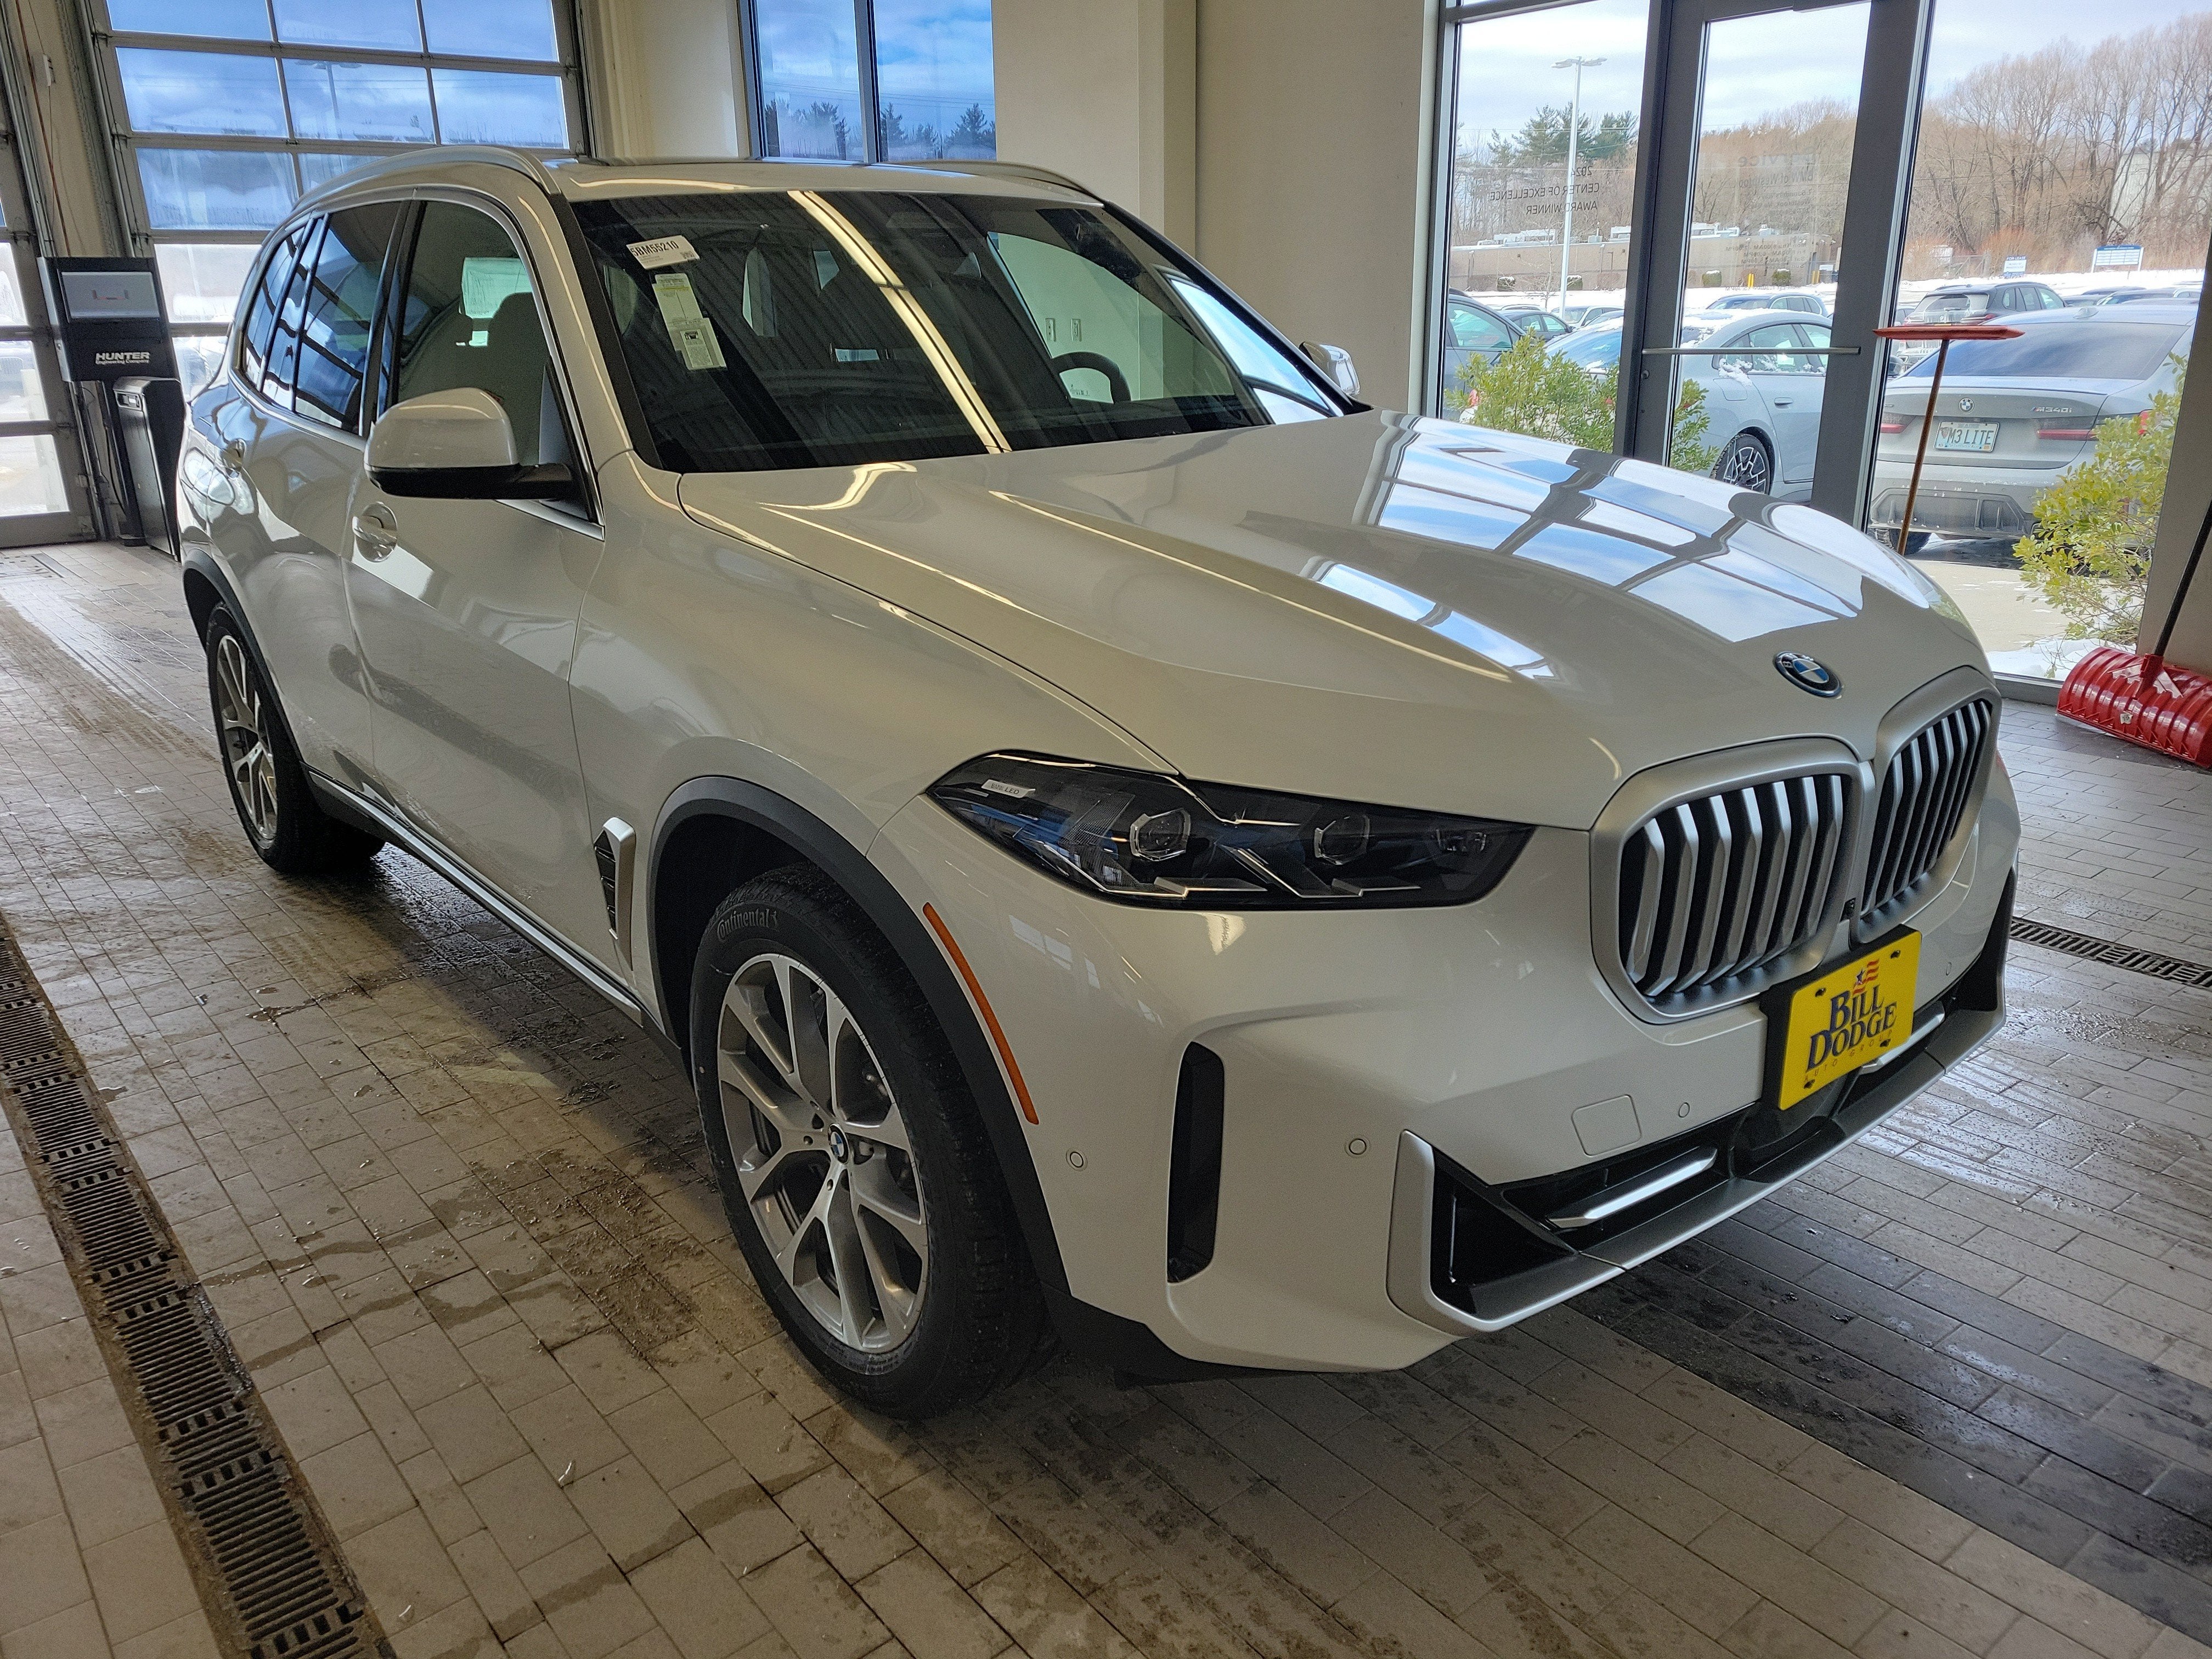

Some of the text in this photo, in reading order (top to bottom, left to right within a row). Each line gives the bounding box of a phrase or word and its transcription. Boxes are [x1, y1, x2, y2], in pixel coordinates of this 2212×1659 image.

[630, 240, 679, 256] 5BM55210
[95, 352, 150, 360] HUNTER
[1947, 428, 1994, 445] M3 LITE
[991, 783, 1005, 791] BMW
[717, 908, 770, 943] Continental
[1829, 984, 1884, 1032] BILL
[1806, 1001, 1897, 1073] DODGE
[1848, 1030, 1893, 1057] GROUP
